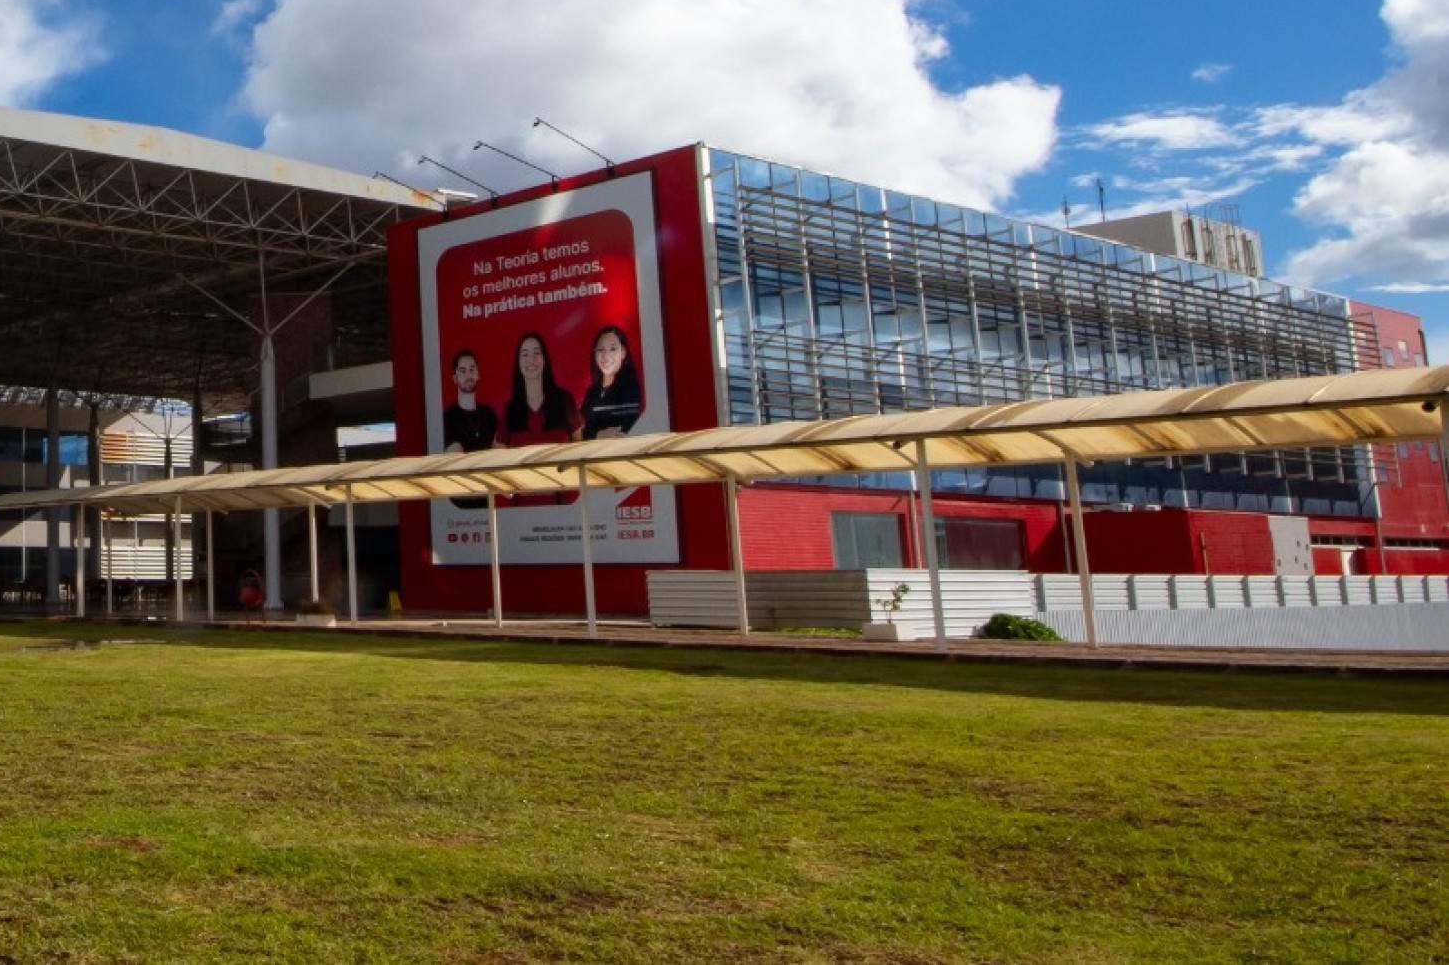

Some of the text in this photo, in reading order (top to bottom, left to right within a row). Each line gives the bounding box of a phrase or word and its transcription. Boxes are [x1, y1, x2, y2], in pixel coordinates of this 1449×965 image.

[473, 240, 590, 276] Na Teoria temos
[462, 260, 604, 298] os melhores alunos.
[462, 281, 608, 319] Na prática também.
[616, 506, 652, 520] IESB
